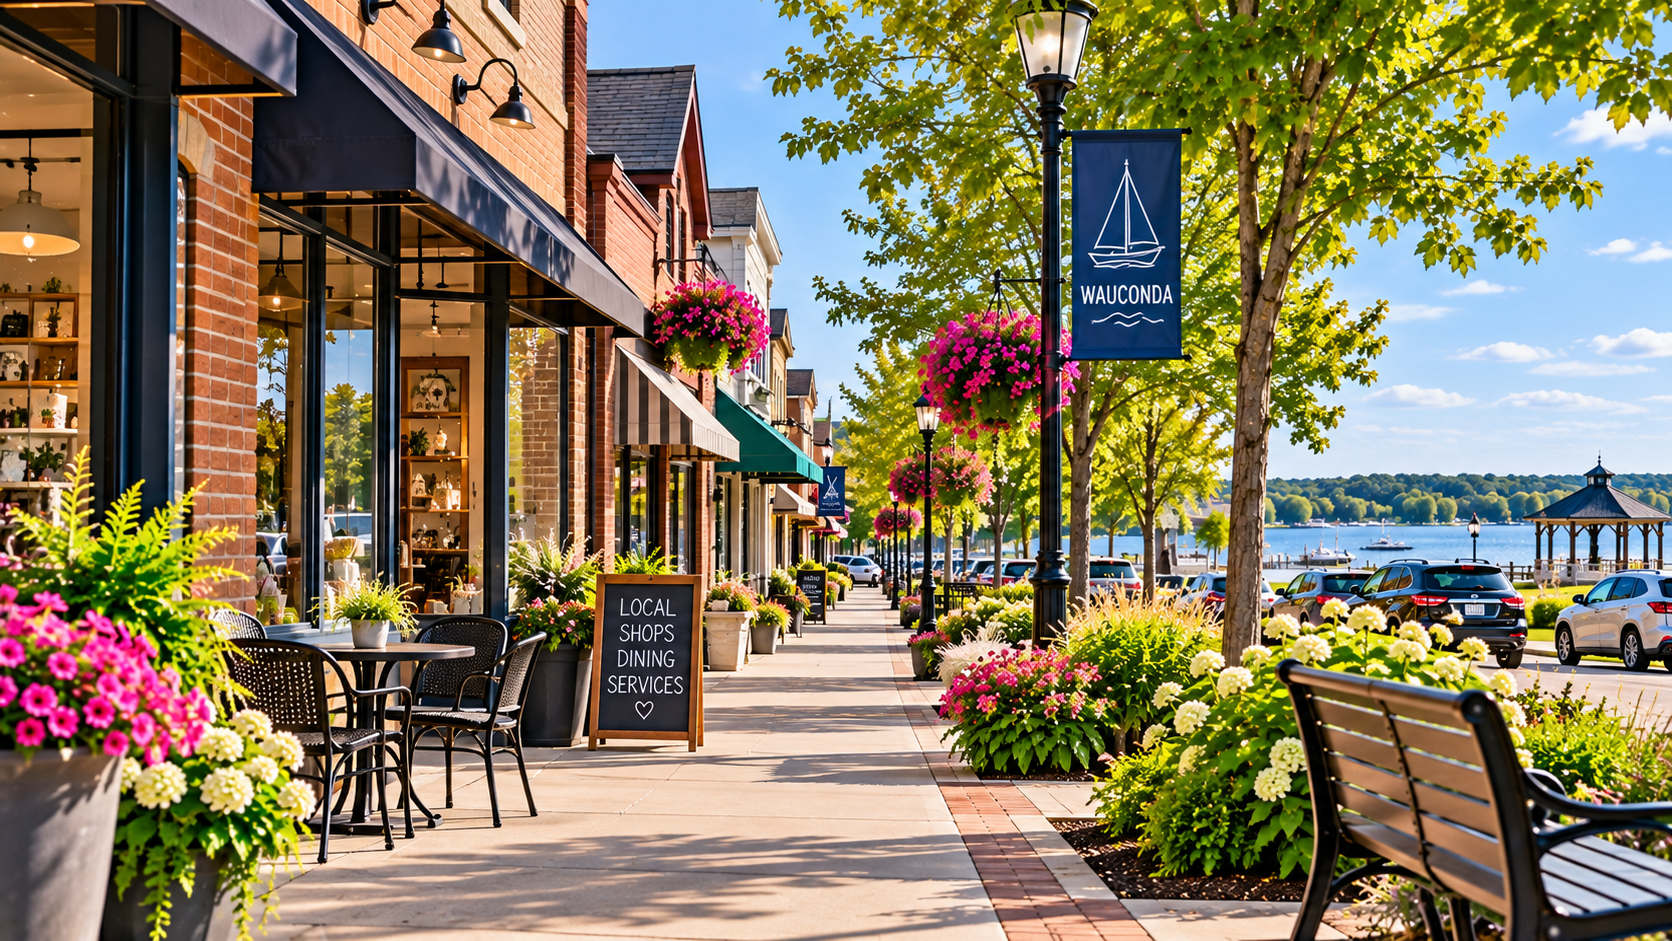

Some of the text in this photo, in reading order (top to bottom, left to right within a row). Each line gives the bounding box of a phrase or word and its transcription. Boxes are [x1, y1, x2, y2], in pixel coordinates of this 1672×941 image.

[1080, 284, 1174, 305] WAUCONDA
[620, 597, 677, 617] LOCAL
[619, 623, 675, 642] SHOPS
[617, 649, 676, 668] DINING
[607, 675, 684, 695] SERVICES
